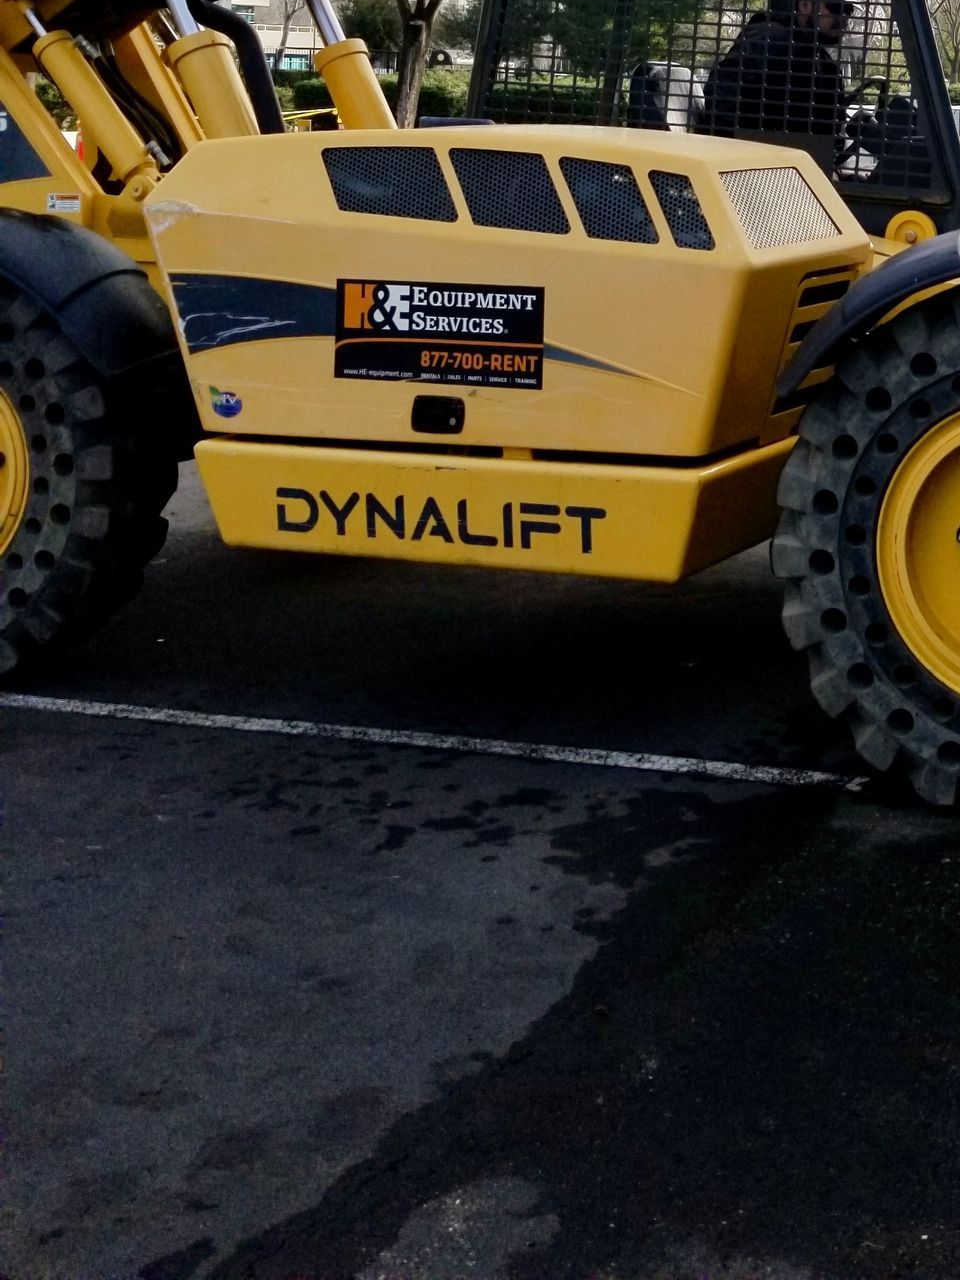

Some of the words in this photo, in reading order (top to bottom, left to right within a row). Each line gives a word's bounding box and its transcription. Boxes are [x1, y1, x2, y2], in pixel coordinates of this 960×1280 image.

[343, 283, 410, 331] H&E
[412, 286, 537, 311] EQUIPMENT
[412, 311, 504, 335] SERVICES
[343, 368, 413, 378] www.HE-equipment.com
[420, 350, 538, 373] 877-700-RENT
[514, 377, 537, 386] TRAINING
[276, 486, 607, 554] DYNALIFT
